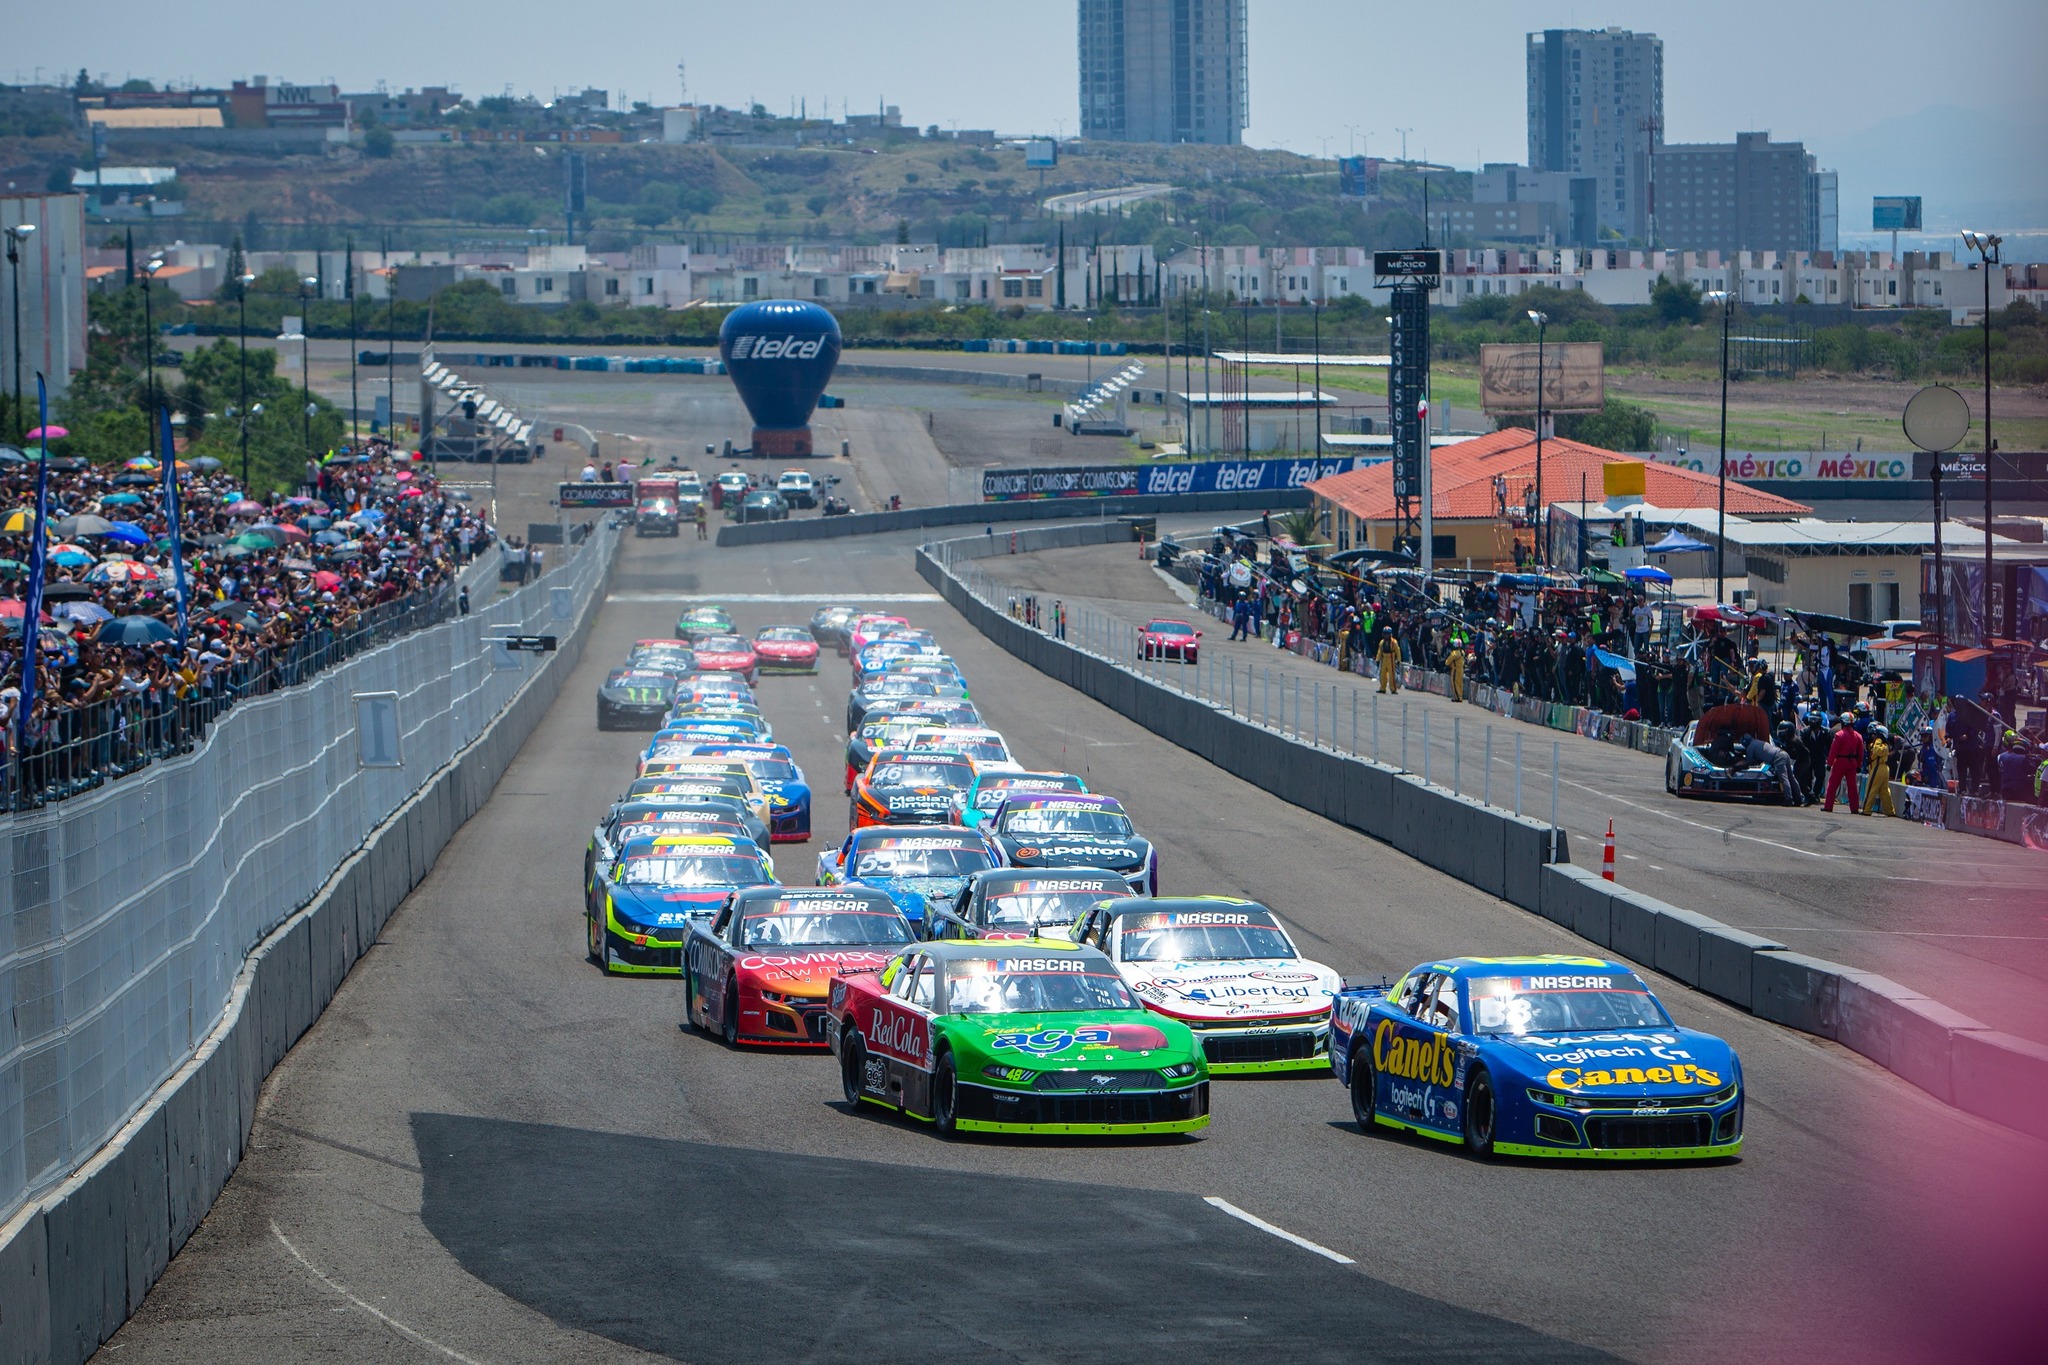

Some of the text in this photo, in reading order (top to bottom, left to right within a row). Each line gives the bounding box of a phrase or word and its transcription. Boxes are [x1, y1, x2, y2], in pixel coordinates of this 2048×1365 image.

[277, 87, 315, 102] NWL
[1387, 260, 1427, 268] MÉXICO
[1395, 313, 1401, 328] 1
[1394, 332, 1402, 347] 2
[751, 334, 827, 359] telcel
[1394, 352, 1402, 366] 3
[1394, 370, 1402, 384] 4
[1394, 389, 1402, 402] 5
[1395, 407, 1402, 420] 6
[1395, 426, 1403, 439] 7
[1396, 444, 1403, 457] 8
[1215, 462, 1265, 490] telcel
[1396, 463, 1403, 476] 9
[984, 475, 1029, 494] COMMSCOPE
[1031, 473, 1081, 491] COMMSCOPE
[1082, 471, 1138, 490] COMMSCOPE
[1147, 465, 1197, 493] telcel
[1394, 480, 1407, 494] 10
[563, 489, 630, 500] COMMSCOPE
[862, 682, 883, 693] 30
[924, 701, 961, 709] NASCAR
[892, 715, 932, 723] NASCAR
[698, 724, 740, 733] NASCAR
[862, 725, 884, 737] 67
[686, 733, 730, 742] NASCAR
[944, 735, 987, 743] NASCAR
[656, 745, 681, 757] 28
[725, 750, 773, 759] NASCAR
[906, 755, 955, 763] NASCAR
[678, 763, 729, 772] NASCAR
[872, 767, 903, 780] 46
[669, 784, 723, 794] NASCAR
[1012, 779, 1064, 789] NASCAR
[976, 789, 1008, 804] 69
[1047, 801, 1102, 810] NASCAR
[661, 812, 720, 822] NASCAR
[900, 838, 963, 848] NASCAR
[672, 845, 736, 855] NASCAR
[857, 854, 898, 873] 55
[1035, 880, 1104, 891] NASCAR
[796, 901, 869, 912] NASCAR
[1175, 913, 1249, 925] NASCAR
[1005, 959, 1086, 972] NASCAR
[766, 968, 811, 981] now
[1530, 976, 1612, 990] NASCAR
[1144, 989, 1166, 1005] SPORTS
[1150, 984, 1169, 999] PRIME
[1210, 985, 1309, 999] Libertad
[982, 1024, 1043, 1036] Sidral
[1244, 1027, 1279, 1035] telcel
[992, 1029, 1112, 1055] aga
[1373, 1018, 1455, 1088] Canel's
[1536, 1046, 1692, 1064] logitech G
[1006, 1068, 1023, 1081] 48
[1546, 1064, 1722, 1089] Canel's
[1084, 1086, 1122, 1094] telcel
[1391, 1082, 1423, 1112] logitech
[1553, 1094, 1566, 1107] 88
[1631, 1107, 1671, 1116] telcel
